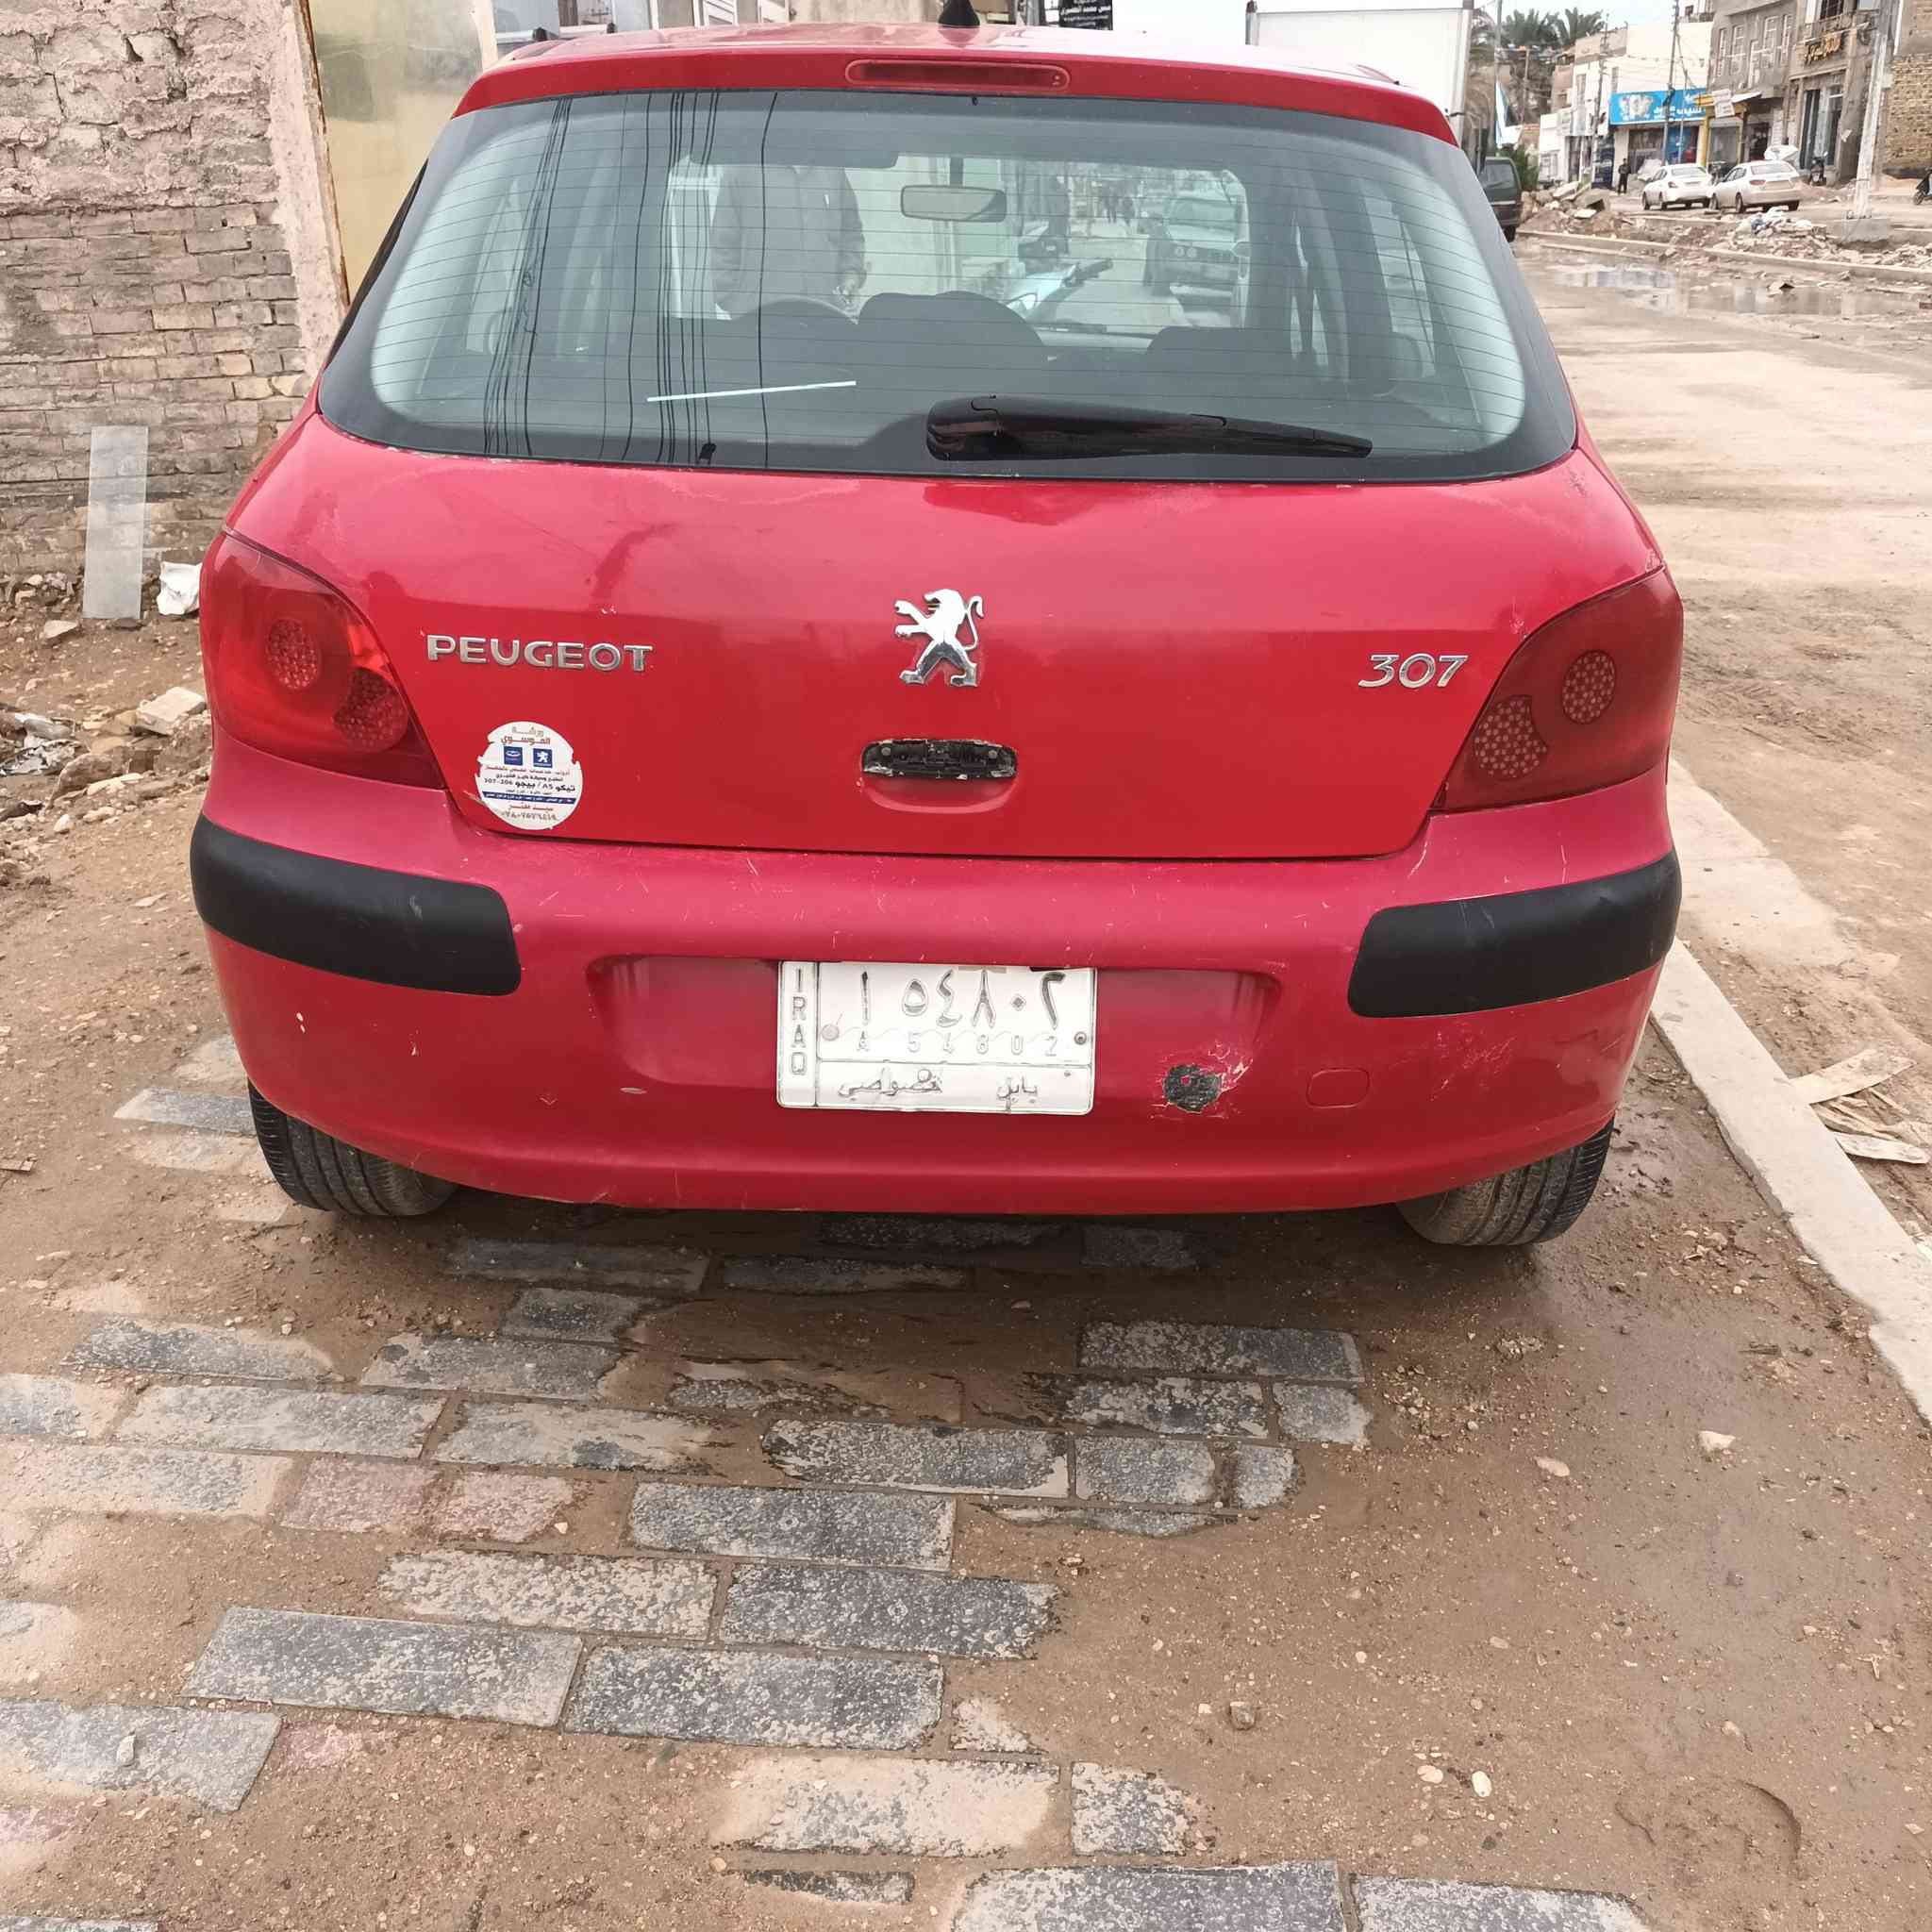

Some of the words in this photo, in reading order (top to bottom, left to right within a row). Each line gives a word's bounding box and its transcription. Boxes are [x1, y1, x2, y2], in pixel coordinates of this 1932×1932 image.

[426, 634, 654, 672] PEUGEOT
[1357, 652, 1469, 689] 307
[791, 968, 808, 1075] IRAQ
